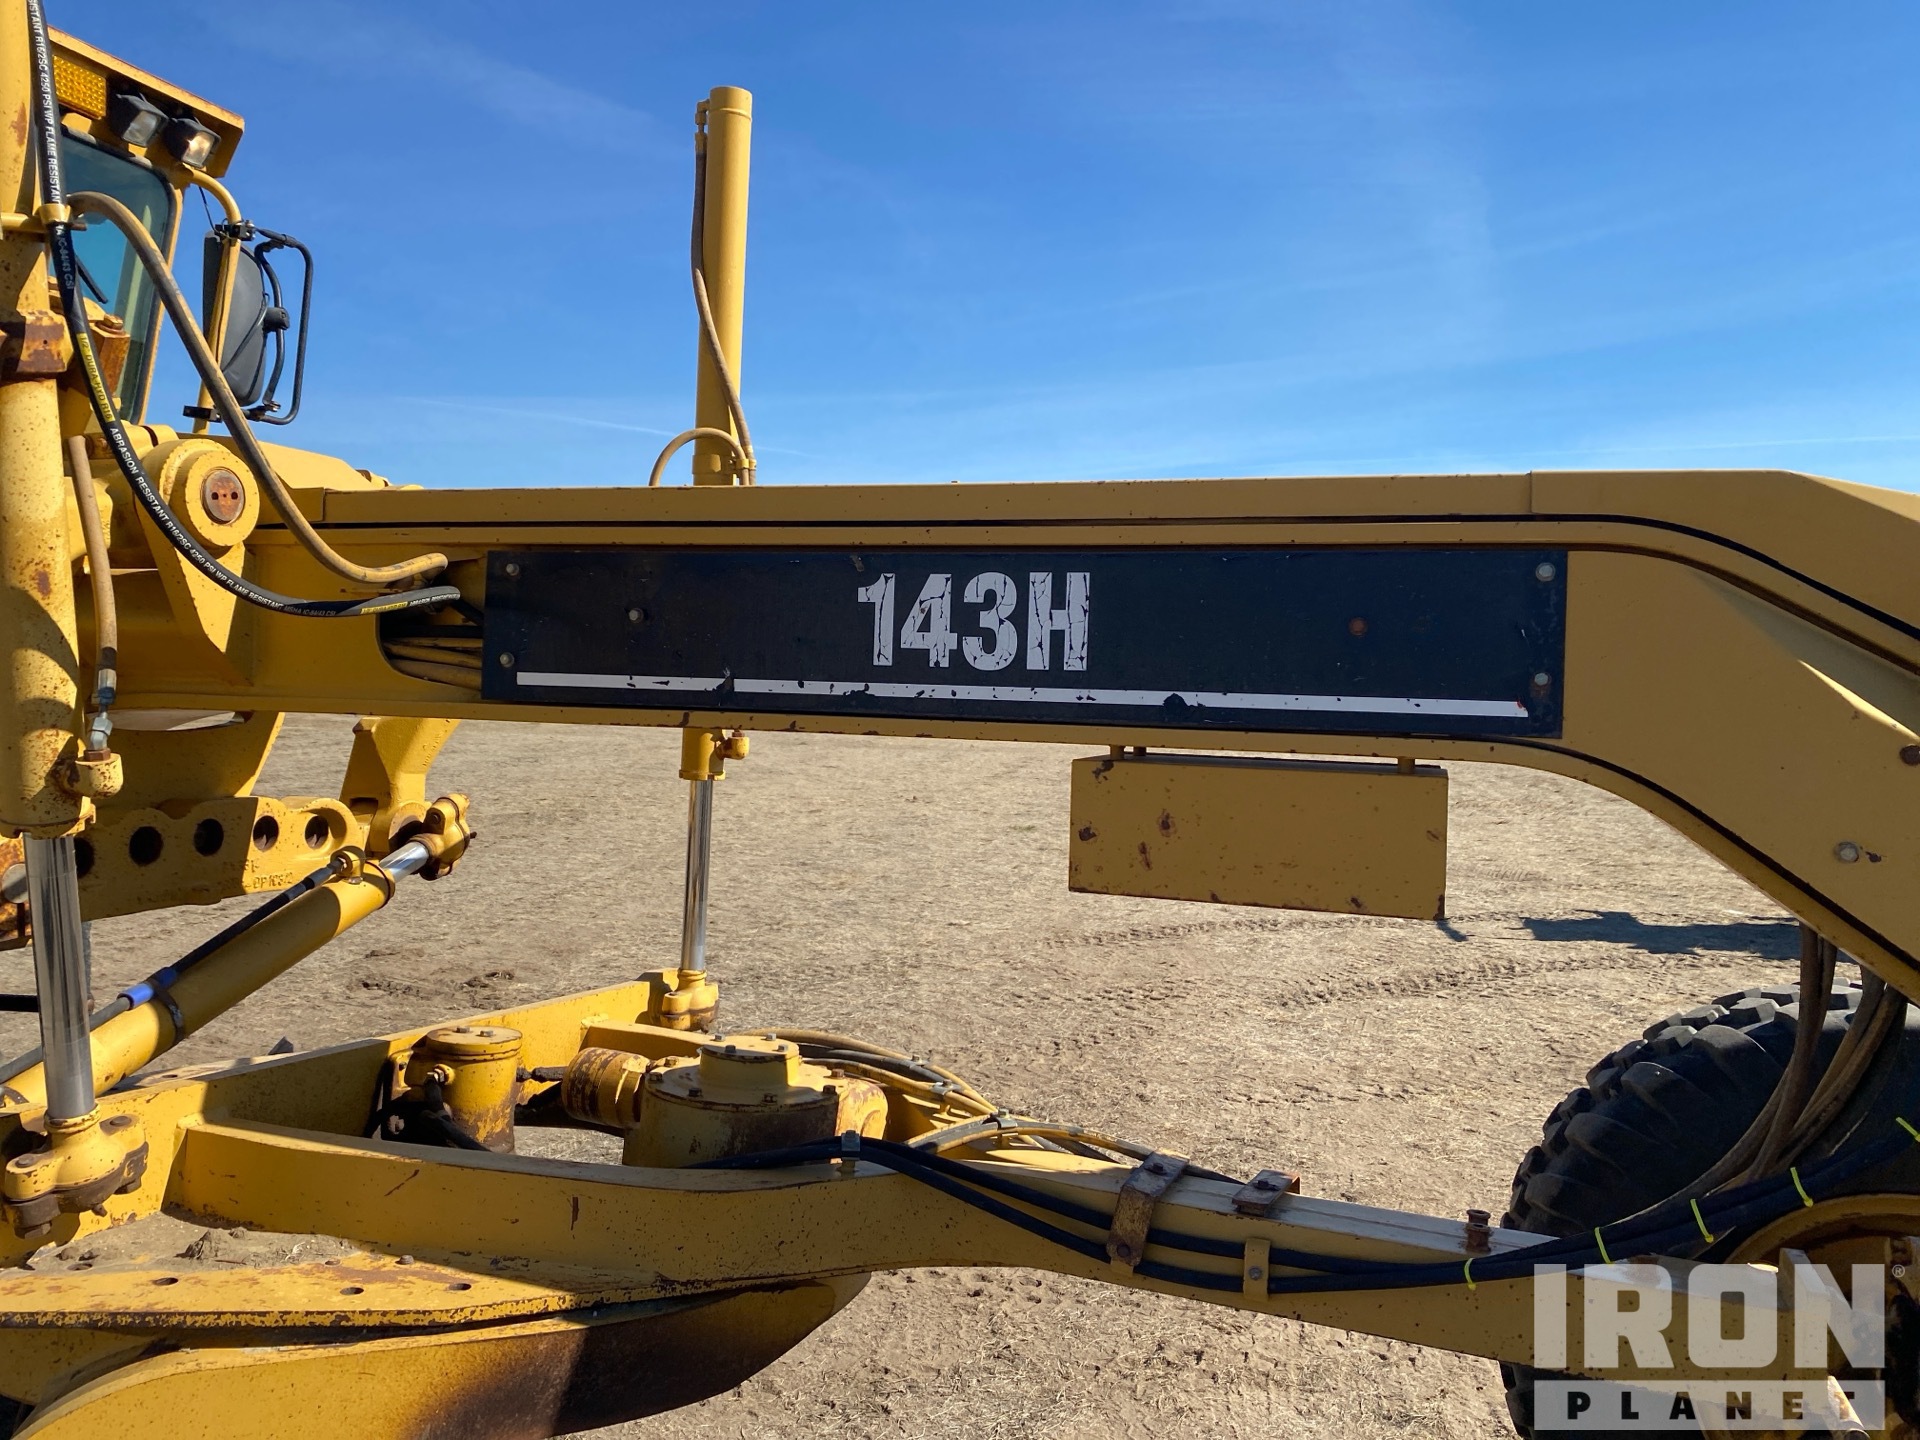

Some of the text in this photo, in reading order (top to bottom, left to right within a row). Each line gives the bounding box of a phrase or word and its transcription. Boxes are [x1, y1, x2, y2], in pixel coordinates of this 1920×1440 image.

[40, 71, 51, 92] 4250
[43, 93, 53, 108] PSI
[44, 108, 54, 126] WP
[46, 126, 57, 156] FLAME
[110, 427, 139, 474] ABRASION
[135, 476, 170, 521] RESISTANT
[189, 549, 206, 564] 4250
[203, 561, 217, 574] PSI
[216, 570, 228, 581] WP
[226, 579, 250, 596] FLAME
[248, 591, 284, 610] RESISTANT
[857, 571, 1091, 671] 143H
